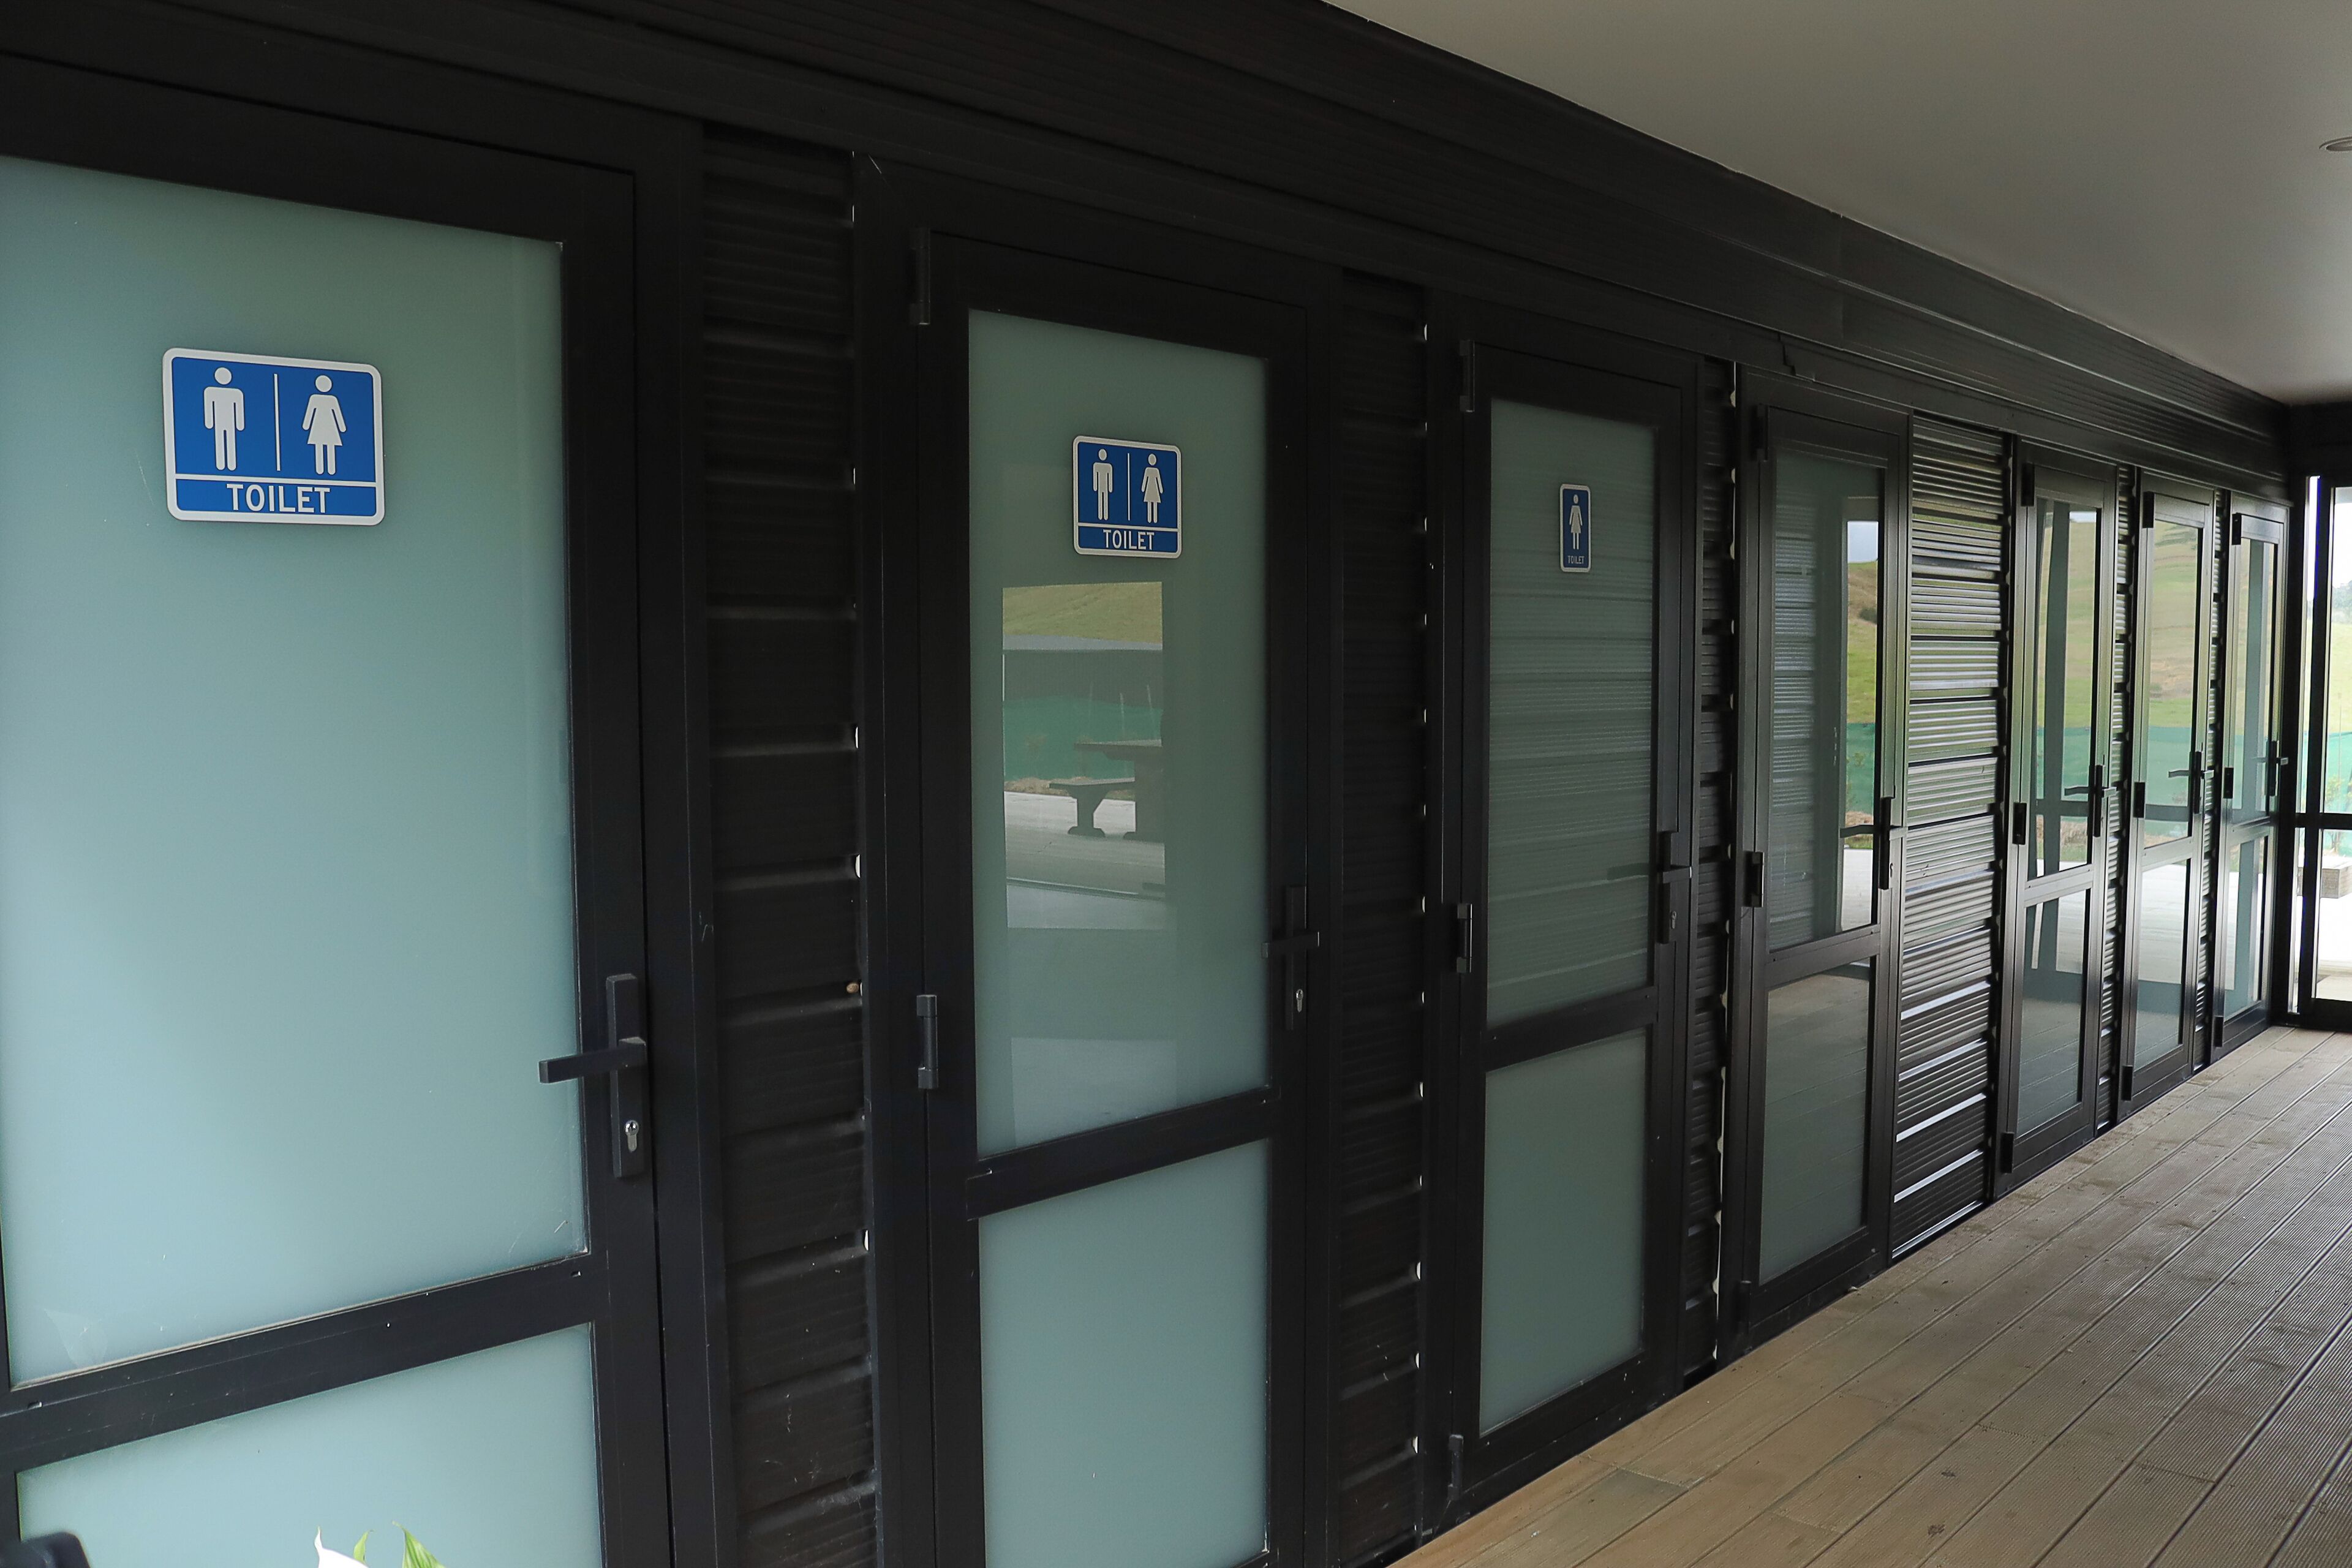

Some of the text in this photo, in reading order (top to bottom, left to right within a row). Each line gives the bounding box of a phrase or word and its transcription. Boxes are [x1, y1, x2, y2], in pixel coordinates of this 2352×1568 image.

[227, 483, 330, 514] TOILET
[1103, 529, 1155, 550] TOILET
[1567, 555, 1585, 564] TOILET
